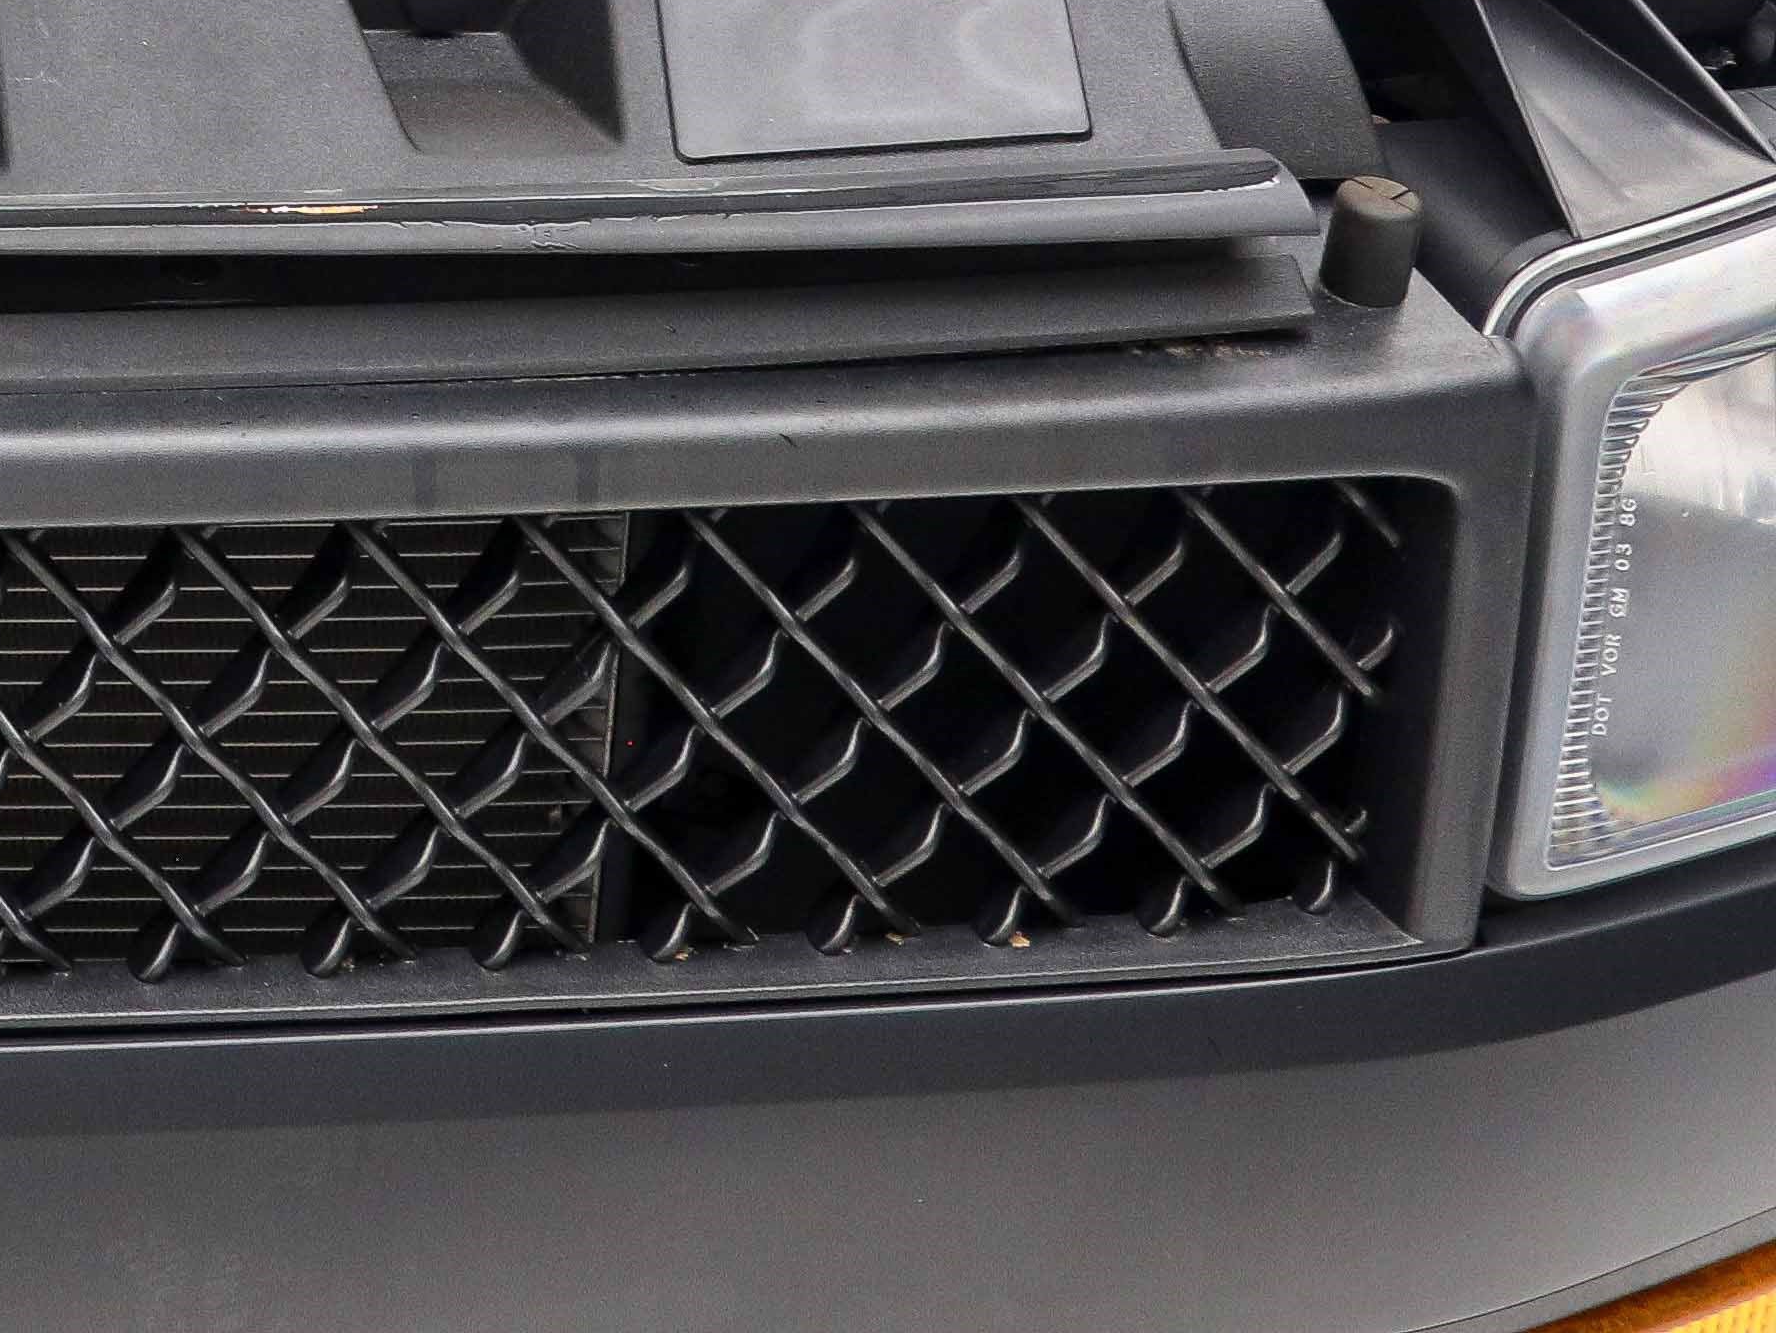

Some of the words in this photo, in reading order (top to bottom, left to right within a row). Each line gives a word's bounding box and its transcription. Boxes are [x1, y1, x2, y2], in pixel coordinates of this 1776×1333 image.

[1621, 496, 1640, 528] 8G
[1614, 541, 1633, 572] 03
[1608, 586, 1631, 618] GM
[1600, 632, 1624, 679] VOR
[1591, 693, 1613, 737] DOT
